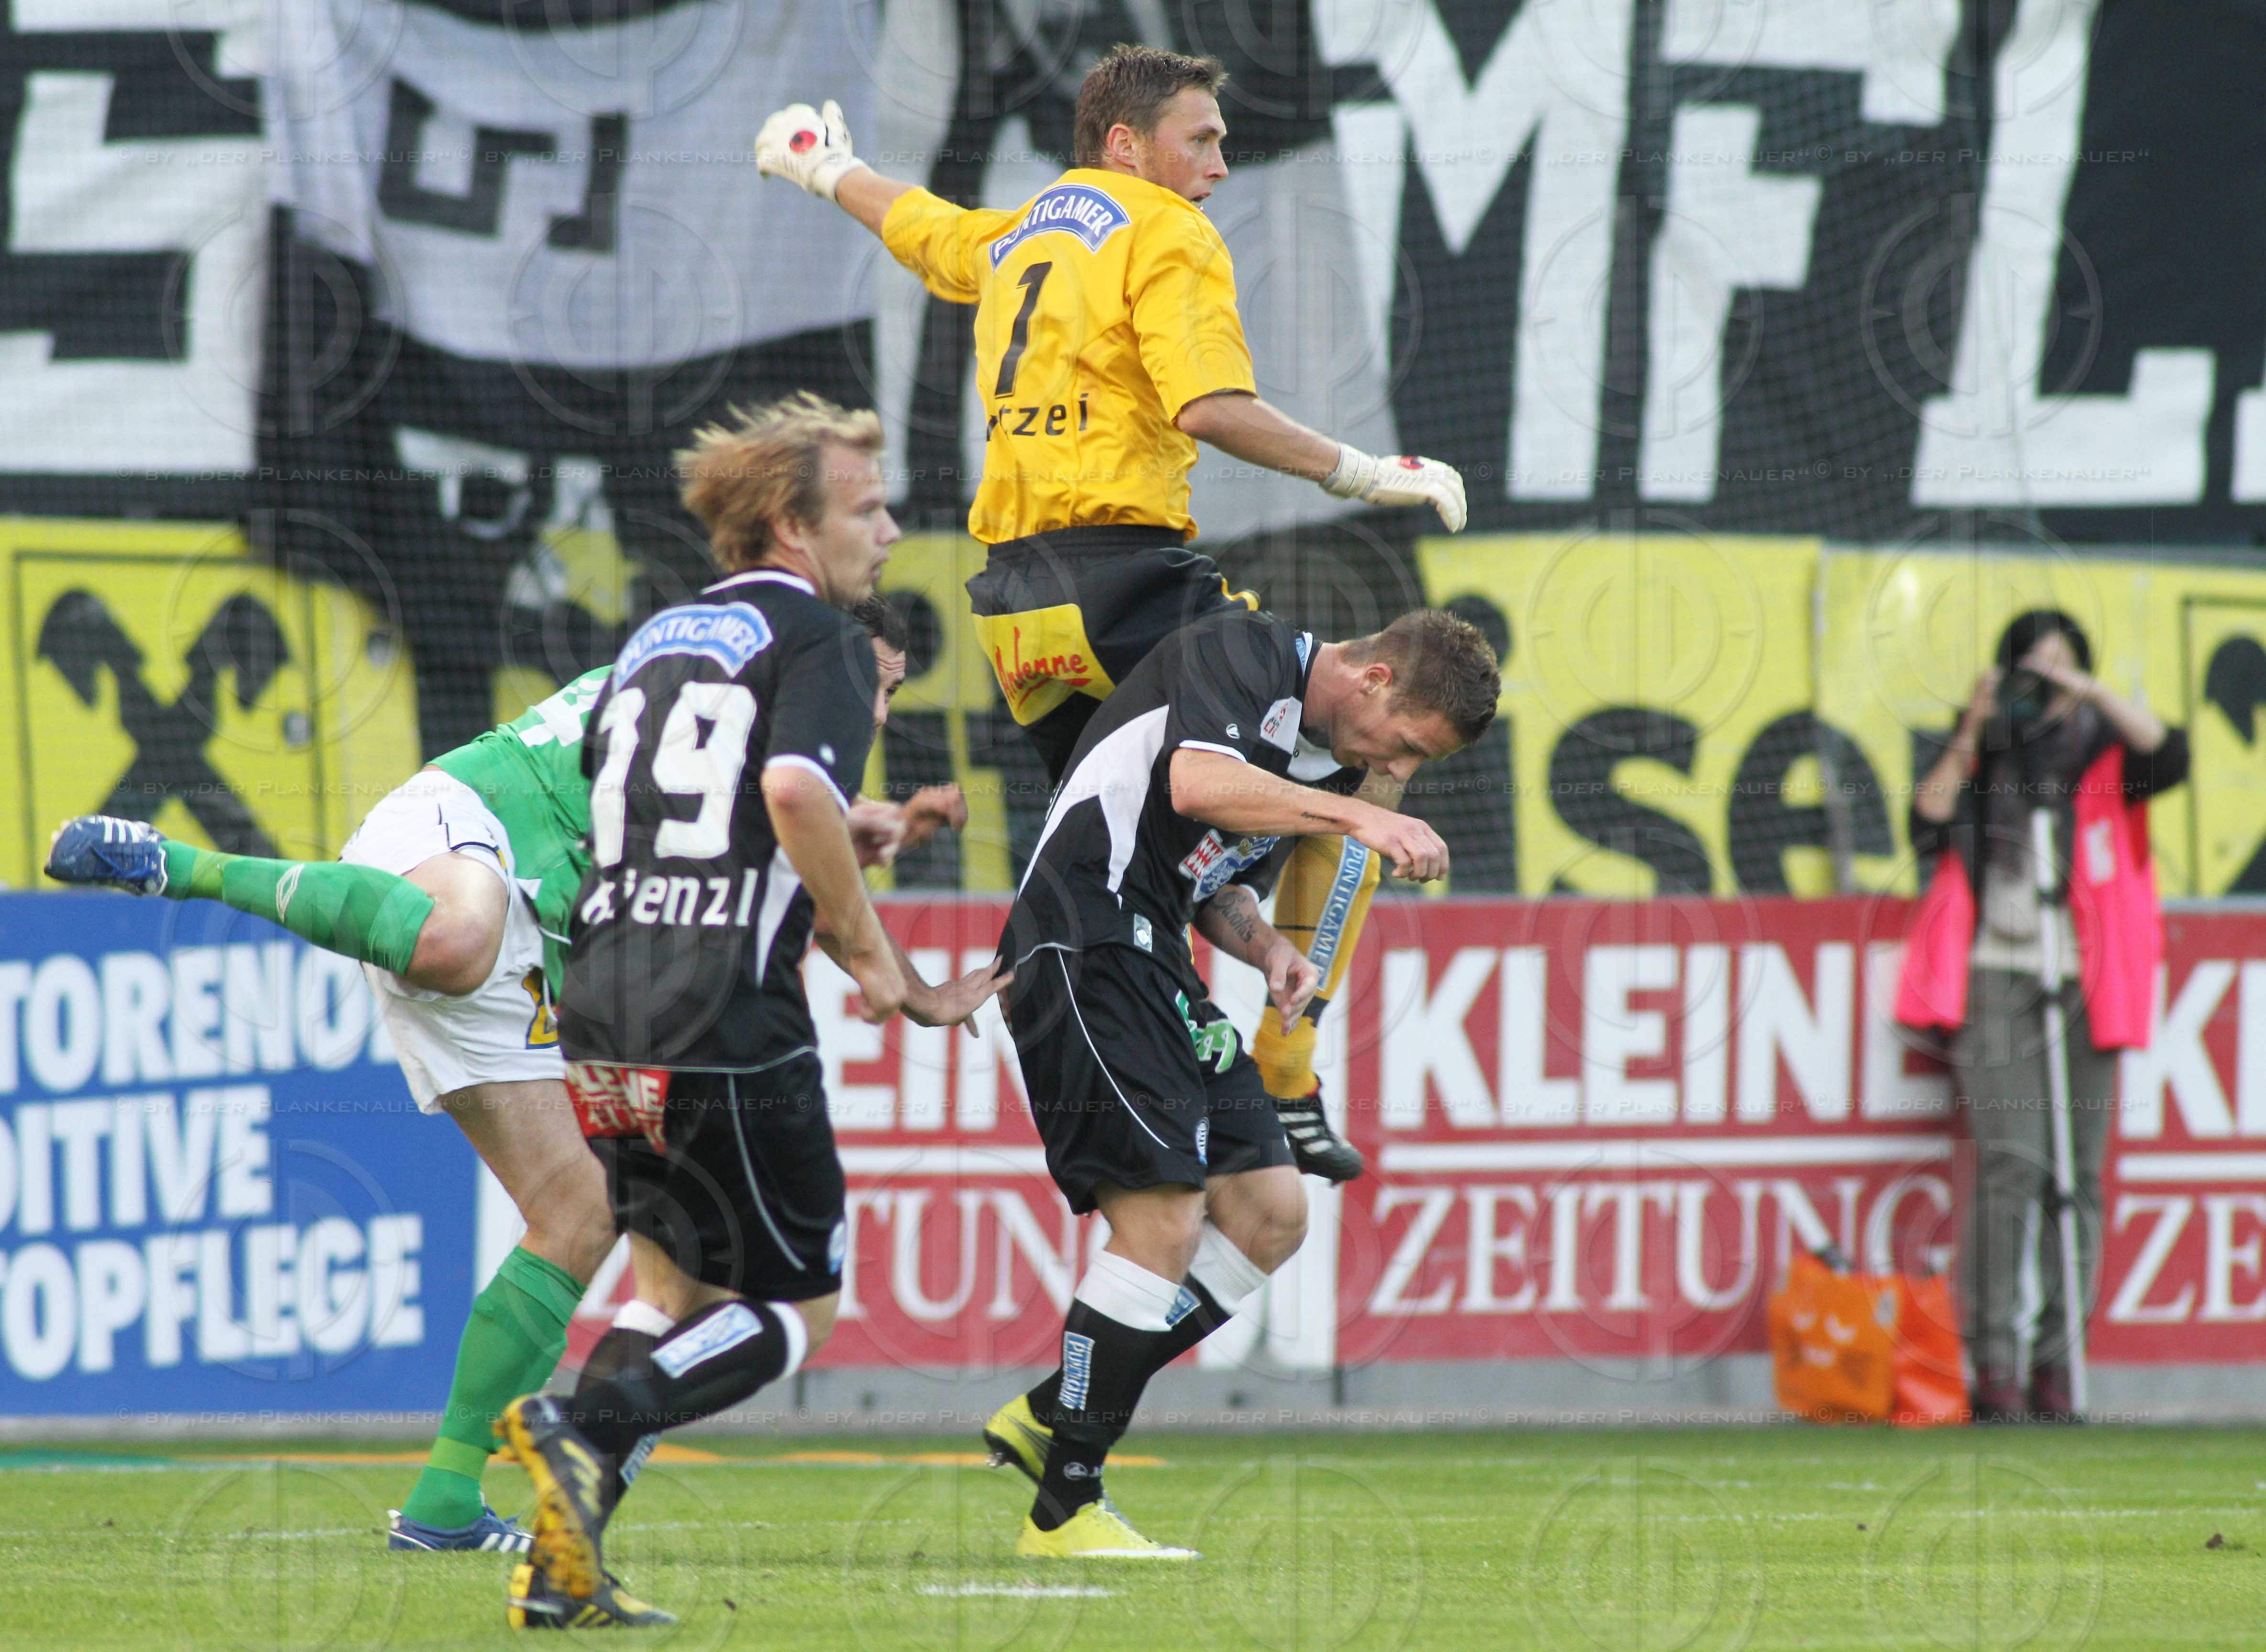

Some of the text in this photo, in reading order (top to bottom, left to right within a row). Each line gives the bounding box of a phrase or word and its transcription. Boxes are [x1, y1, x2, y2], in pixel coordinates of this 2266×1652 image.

[996, 261, 1052, 400] 1
[591, 680, 757, 868] 19
[580, 867, 759, 926] Kienzl
[1379, 941, 1953, 1130] KLEINE
[0, 1214, 425, 1380] OPFLEGE
[1365, 1173, 1953, 1316] ZEITUNG
